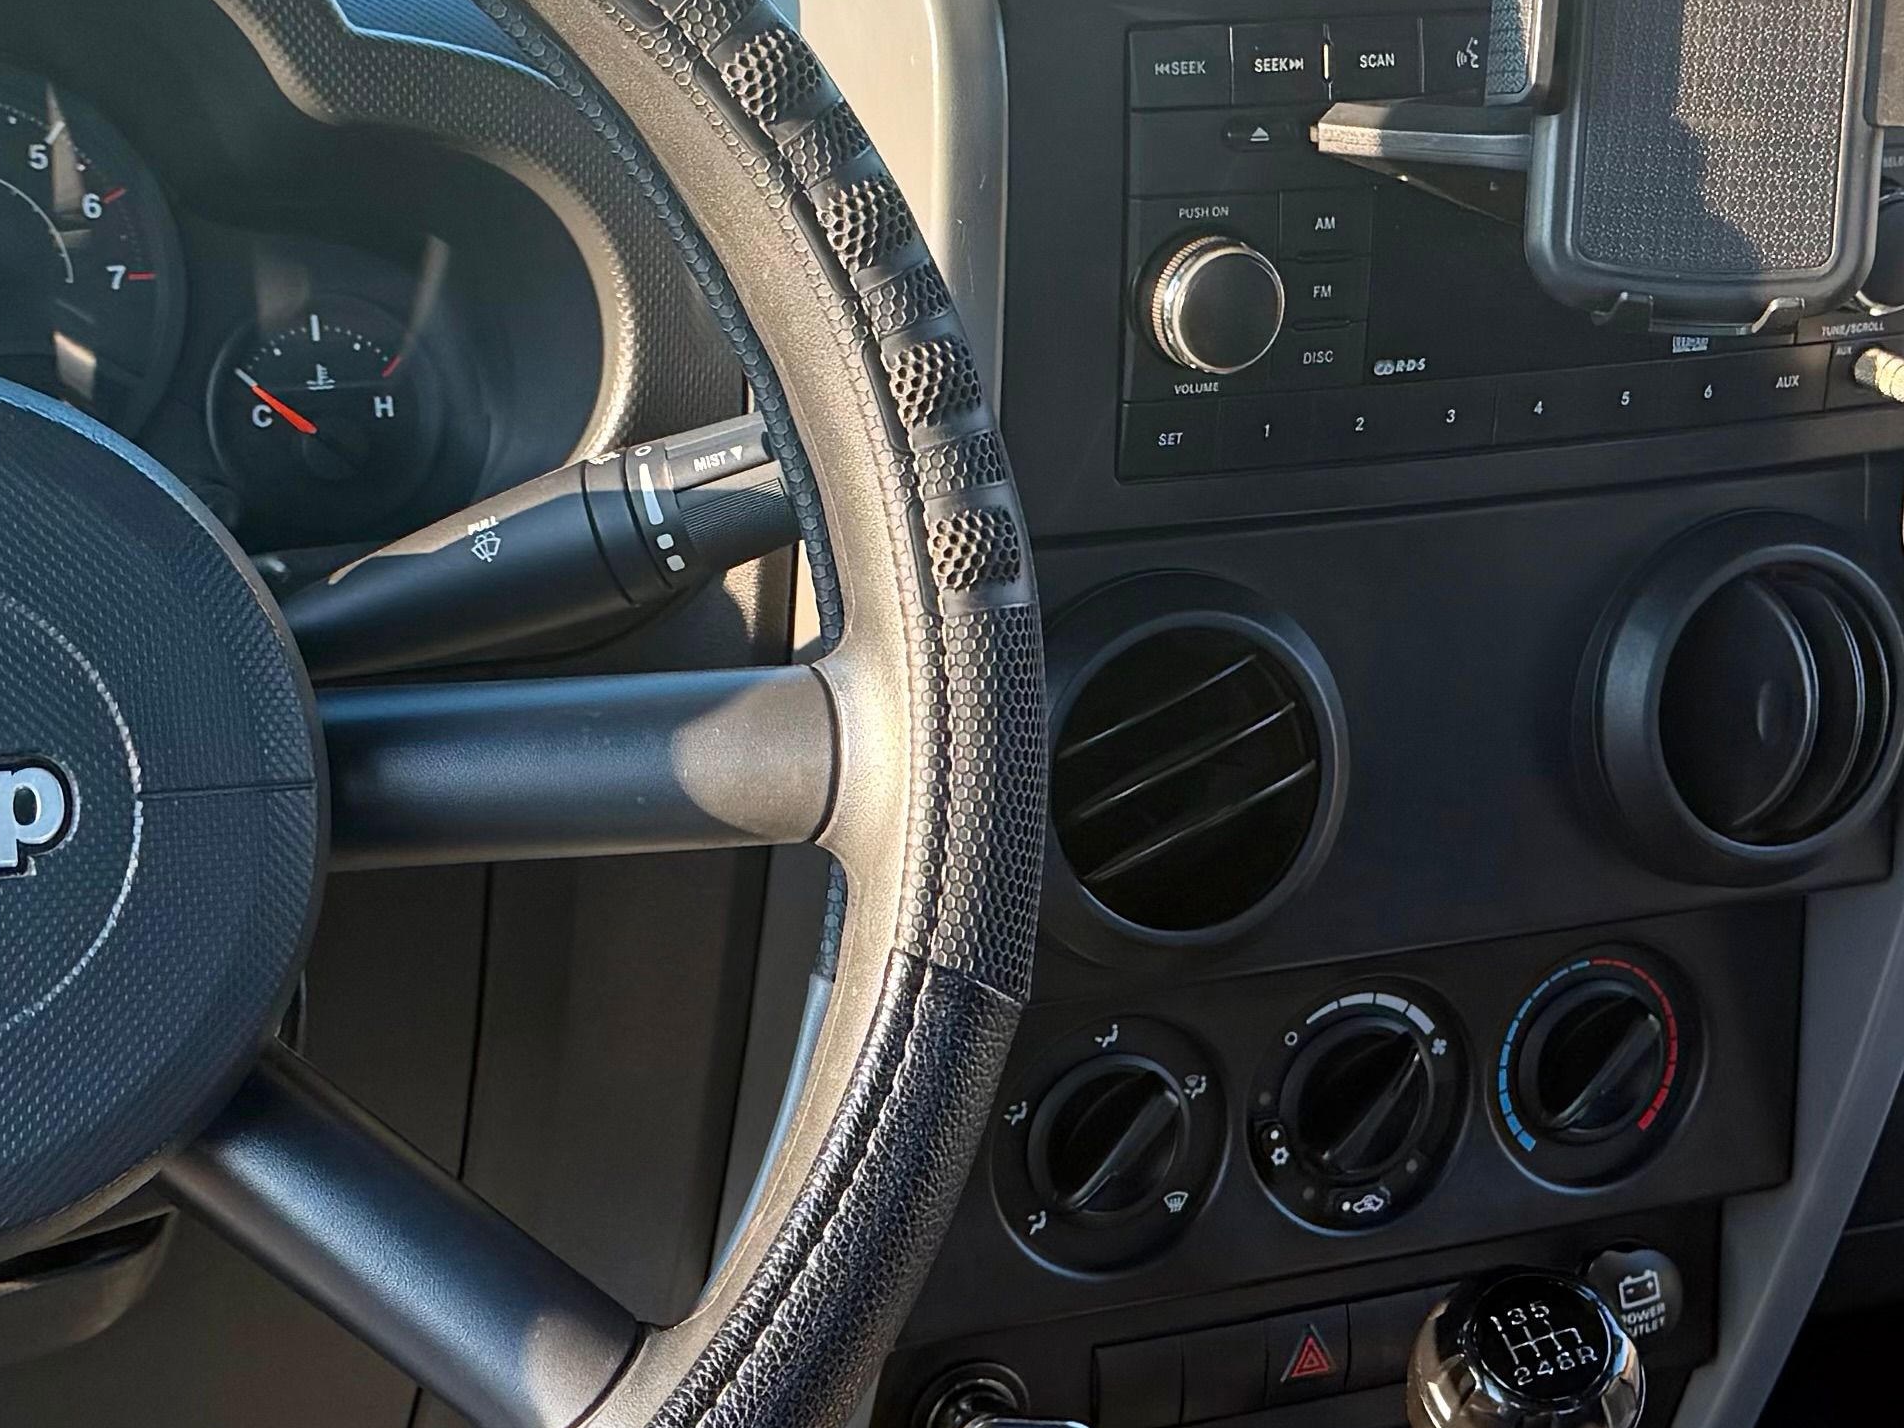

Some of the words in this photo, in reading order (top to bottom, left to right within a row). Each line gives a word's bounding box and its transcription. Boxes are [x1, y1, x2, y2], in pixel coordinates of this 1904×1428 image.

[1170, 60, 1207, 75] SEEK
[1254, 57, 1290, 73] SEEK
[1359, 53, 1396, 69] SCAN
[27, 143, 49, 170] 5
[81, 192, 103, 219] 6
[1178, 207, 1210, 219] PUSH
[1212, 205, 1230, 218] ON
[1314, 216, 1336, 231] AM
[105, 264, 127, 291] 7
[1312, 285, 1333, 299] FM
[1821, 321, 1886, 336] TUNE/SCROLL
[1302, 350, 1335, 365] DISC
[1173, 381, 1220, 395] VOLUME
[1775, 374, 1801, 390] AUX
[1620, 390, 1631, 406] 5
[1703, 384, 1713, 400] 6
[372, 394, 395, 419] H
[1533, 400, 1544, 416] 4
[251, 404, 274, 428] C
[1354, 416, 1365, 432] 2
[1445, 408, 1456, 424] 3
[1157, 431, 1184, 446] SET
[1263, 424, 1272, 439] 1
[693, 450, 728, 473] MIST
[466, 515, 500, 536] PULL
[1489, 1315, 1503, 1332] 1
[1506, 1307, 1528, 1326] 3
[1529, 1300, 1550, 1319] 5
[1513, 1366, 1534, 1387] 2
[1536, 1360, 1554, 1376] 4
[1575, 1345, 1599, 1365] R
